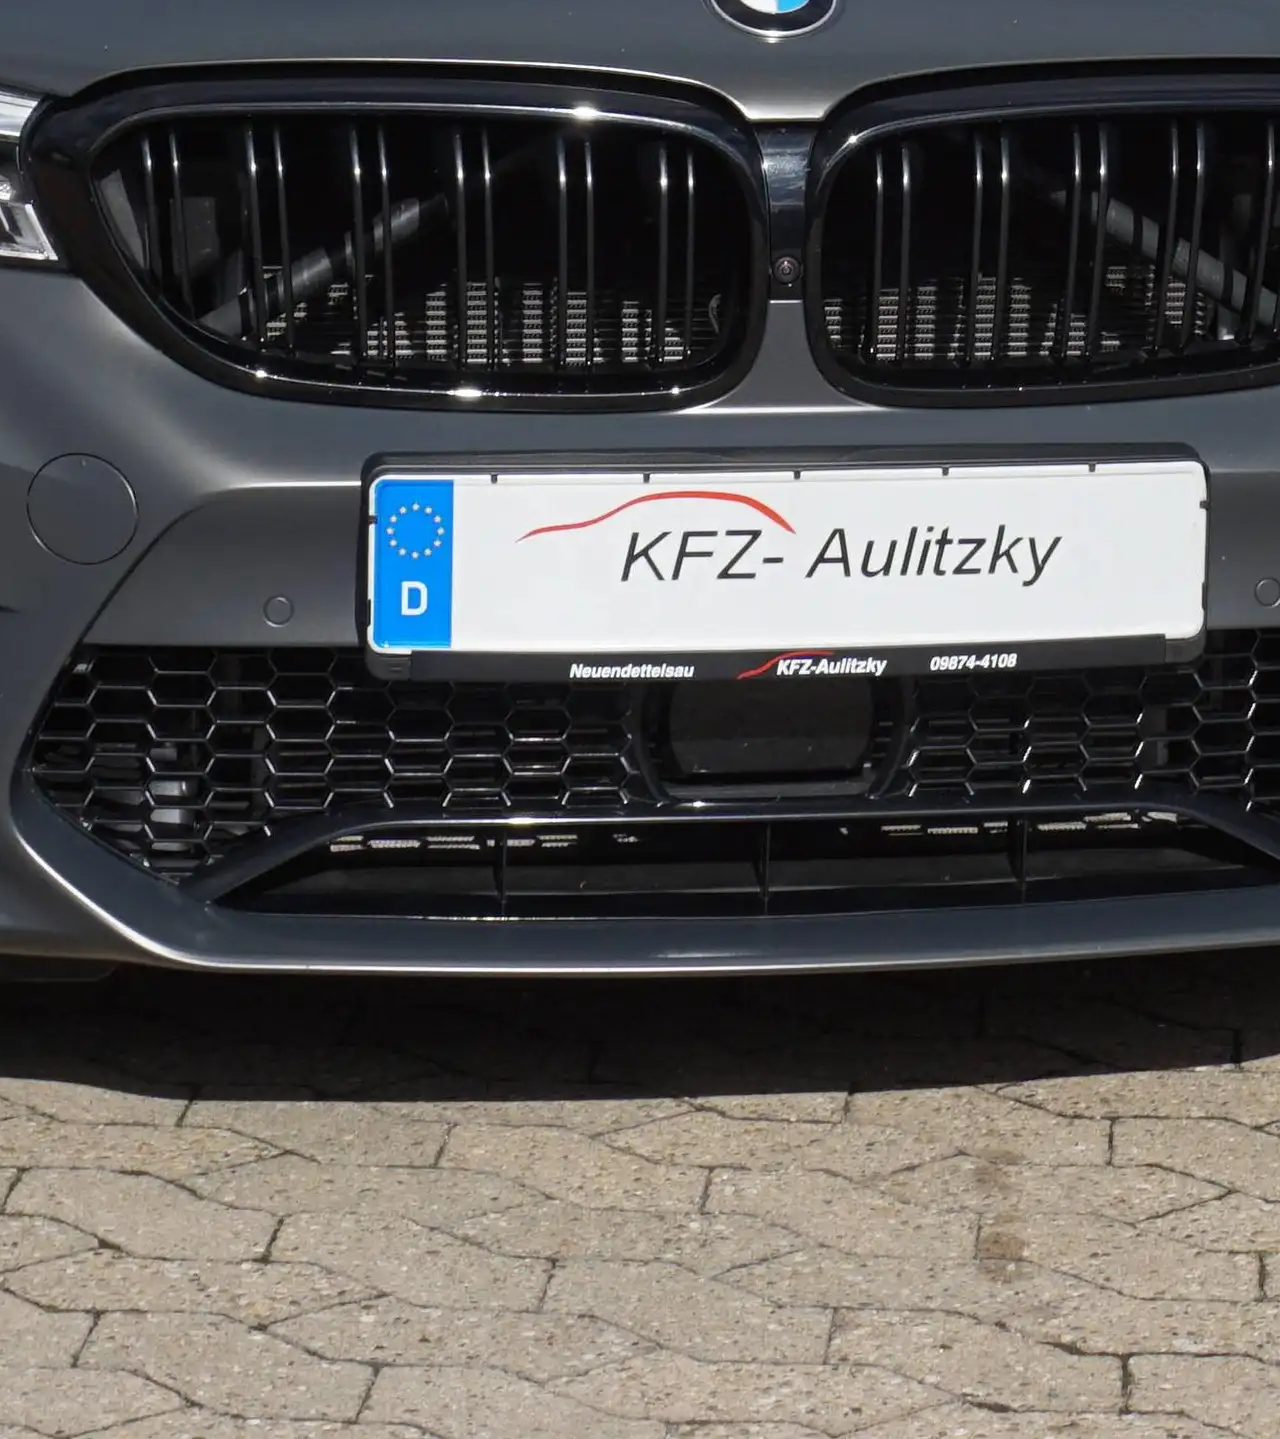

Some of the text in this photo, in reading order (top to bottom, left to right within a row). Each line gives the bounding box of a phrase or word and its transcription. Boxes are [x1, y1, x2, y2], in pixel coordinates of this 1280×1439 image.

[620, 524, 1063, 587] KFZ- Aulitzky
[400, 580, 429, 616] D
[569, 652, 1018, 680] Neuendettelsau KFZ-Aulitzky 09874-4108
